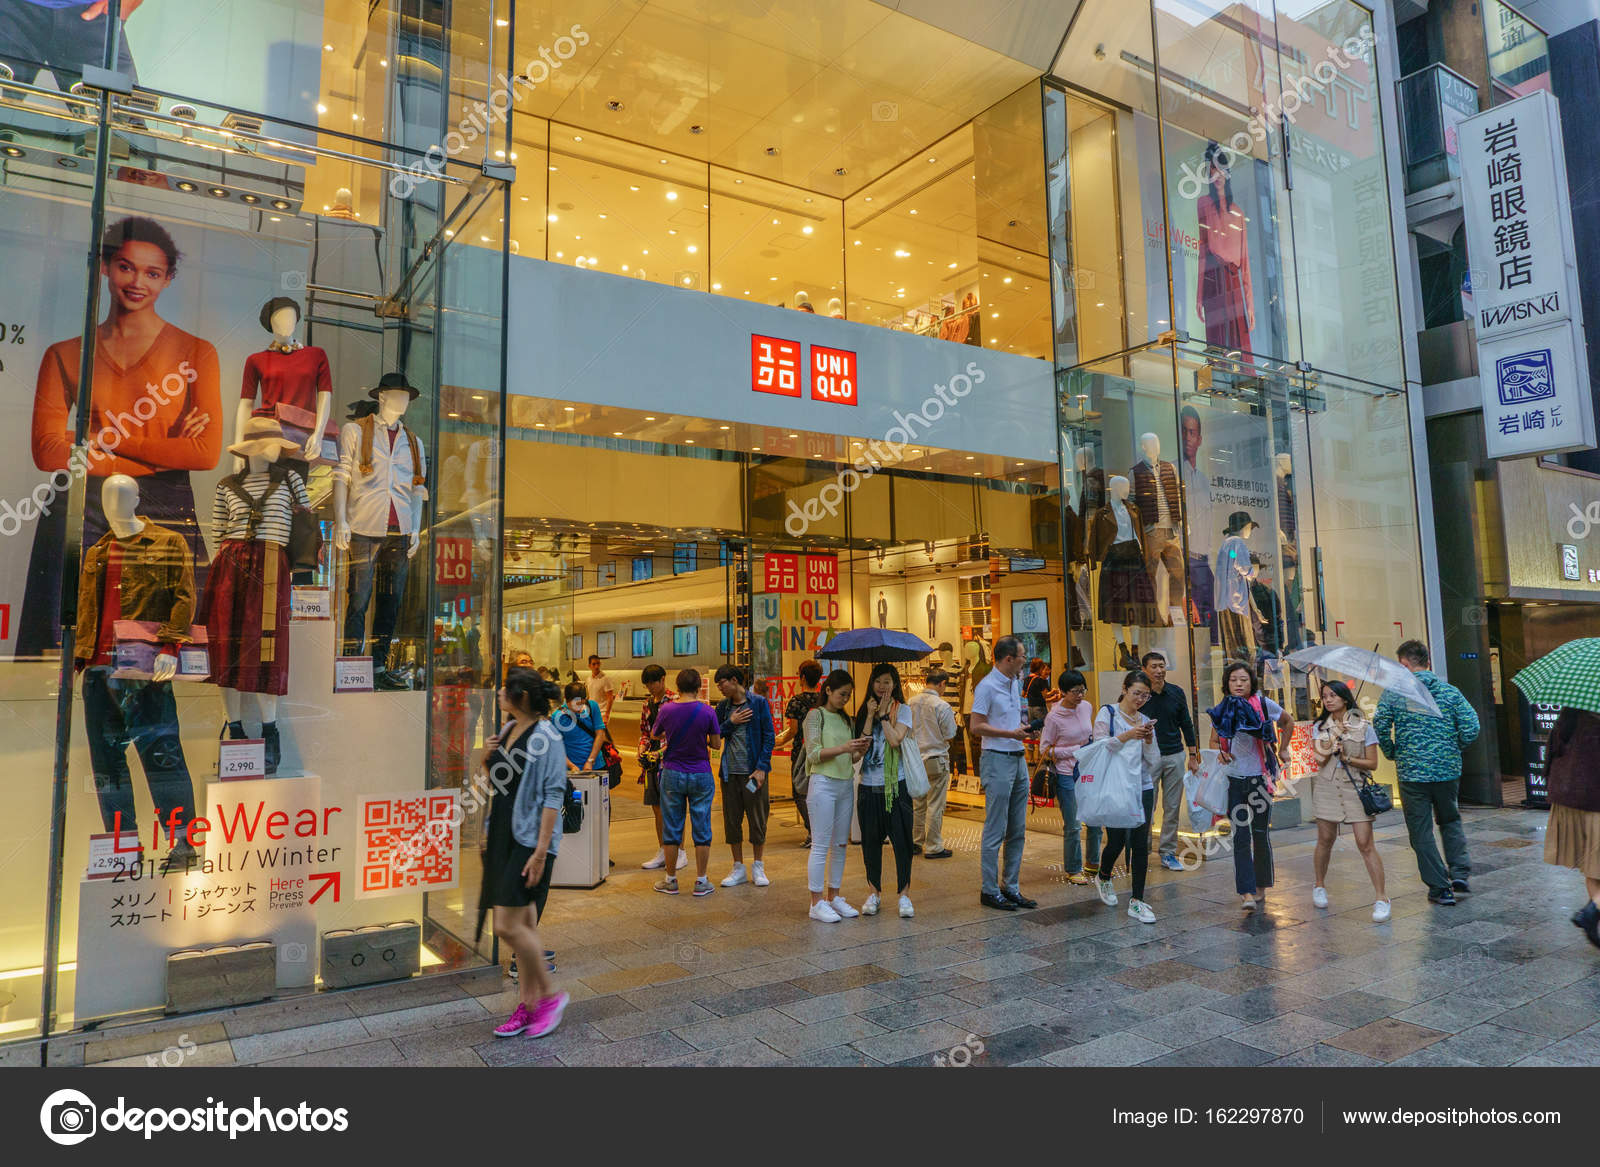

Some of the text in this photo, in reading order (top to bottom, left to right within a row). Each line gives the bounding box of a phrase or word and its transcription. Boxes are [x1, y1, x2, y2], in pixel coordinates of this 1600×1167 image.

[1484, 118, 1533, 291] 岩崎眼鏡店
[816, 353, 848, 377] UNI
[816, 375, 852, 399] QLO
[810, 560, 833, 575] UNI
[810, 576, 835, 592] QLO
[765, 598, 839, 624] UNIQLO
[766, 682, 797, 700] TAX
[112, 857, 172, 883] 2017
[111, 882, 257, 909] メリノ ジャケット
[270, 877, 304, 891] Here
[270, 890, 304, 902] Press
[110, 899, 257, 927] スカート ジーンズ
[269, 900, 304, 910] Preview
